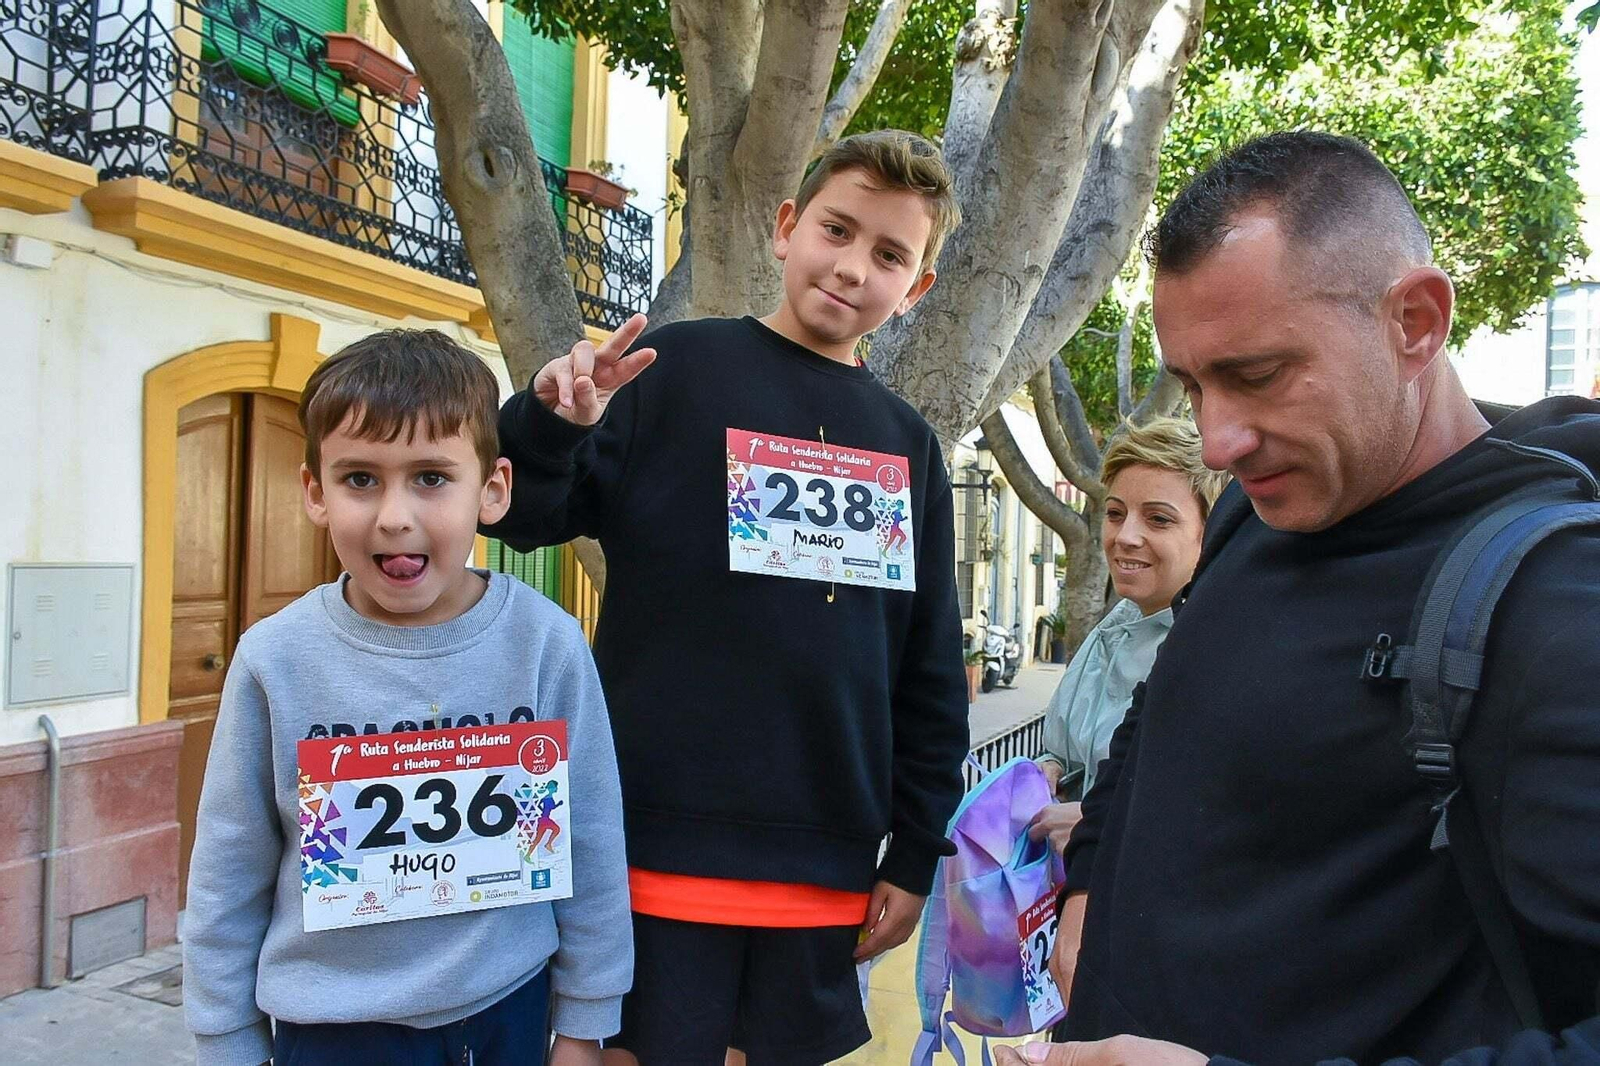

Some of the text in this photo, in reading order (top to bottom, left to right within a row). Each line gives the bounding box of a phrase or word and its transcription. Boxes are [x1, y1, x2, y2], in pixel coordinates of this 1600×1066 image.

[769, 441, 789, 453] Ruta
[792, 445, 833, 460] Senderista
[836, 452, 871, 466] Solidaria
[887, 468, 894, 480] 3
[765, 473, 876, 532] 238
[360, 742, 389, 757] Ruta
[394, 737, 455, 754] Senderista
[460, 733, 511, 749] Solidaria
[534, 739, 545, 757] 3
[393, 763, 399, 771] a
[404, 757, 441, 770] Huebro
[532, 764, 549, 772] 2022
[354, 775, 518, 850] 236
